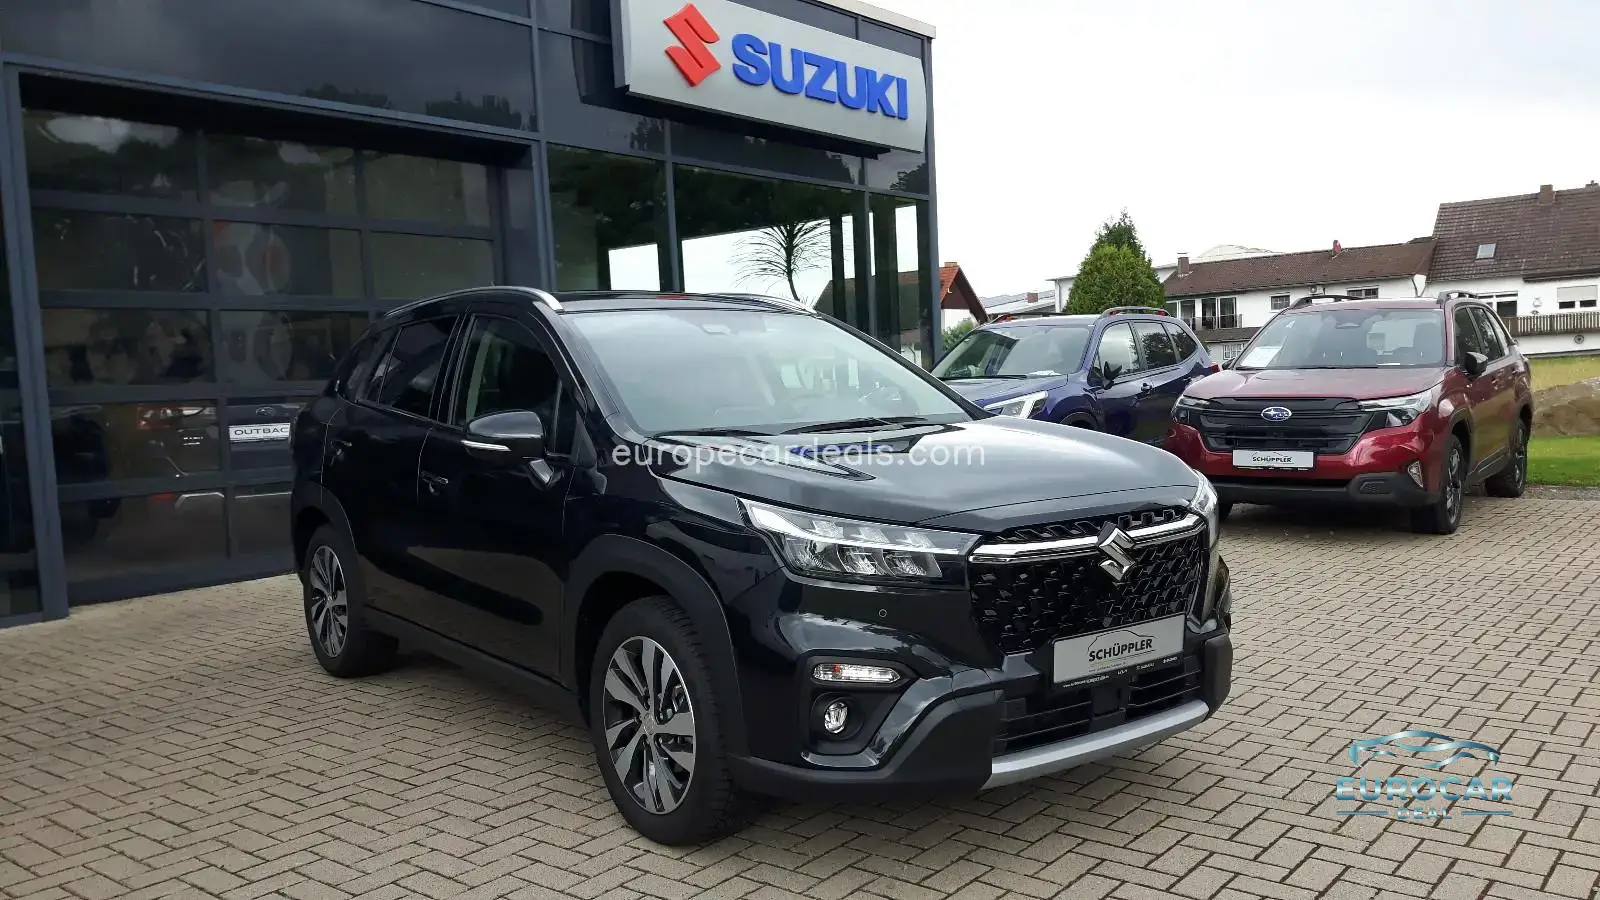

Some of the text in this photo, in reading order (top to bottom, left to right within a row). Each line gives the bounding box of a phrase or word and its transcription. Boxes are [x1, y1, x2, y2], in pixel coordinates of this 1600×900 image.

[731, 33, 909, 121] SUZUKI
[234, 427, 289, 436] OUTBAC
[1252, 455, 1293, 463] SCHÜPPLER
[1088, 638, 1153, 662] SCHÜPPLER
